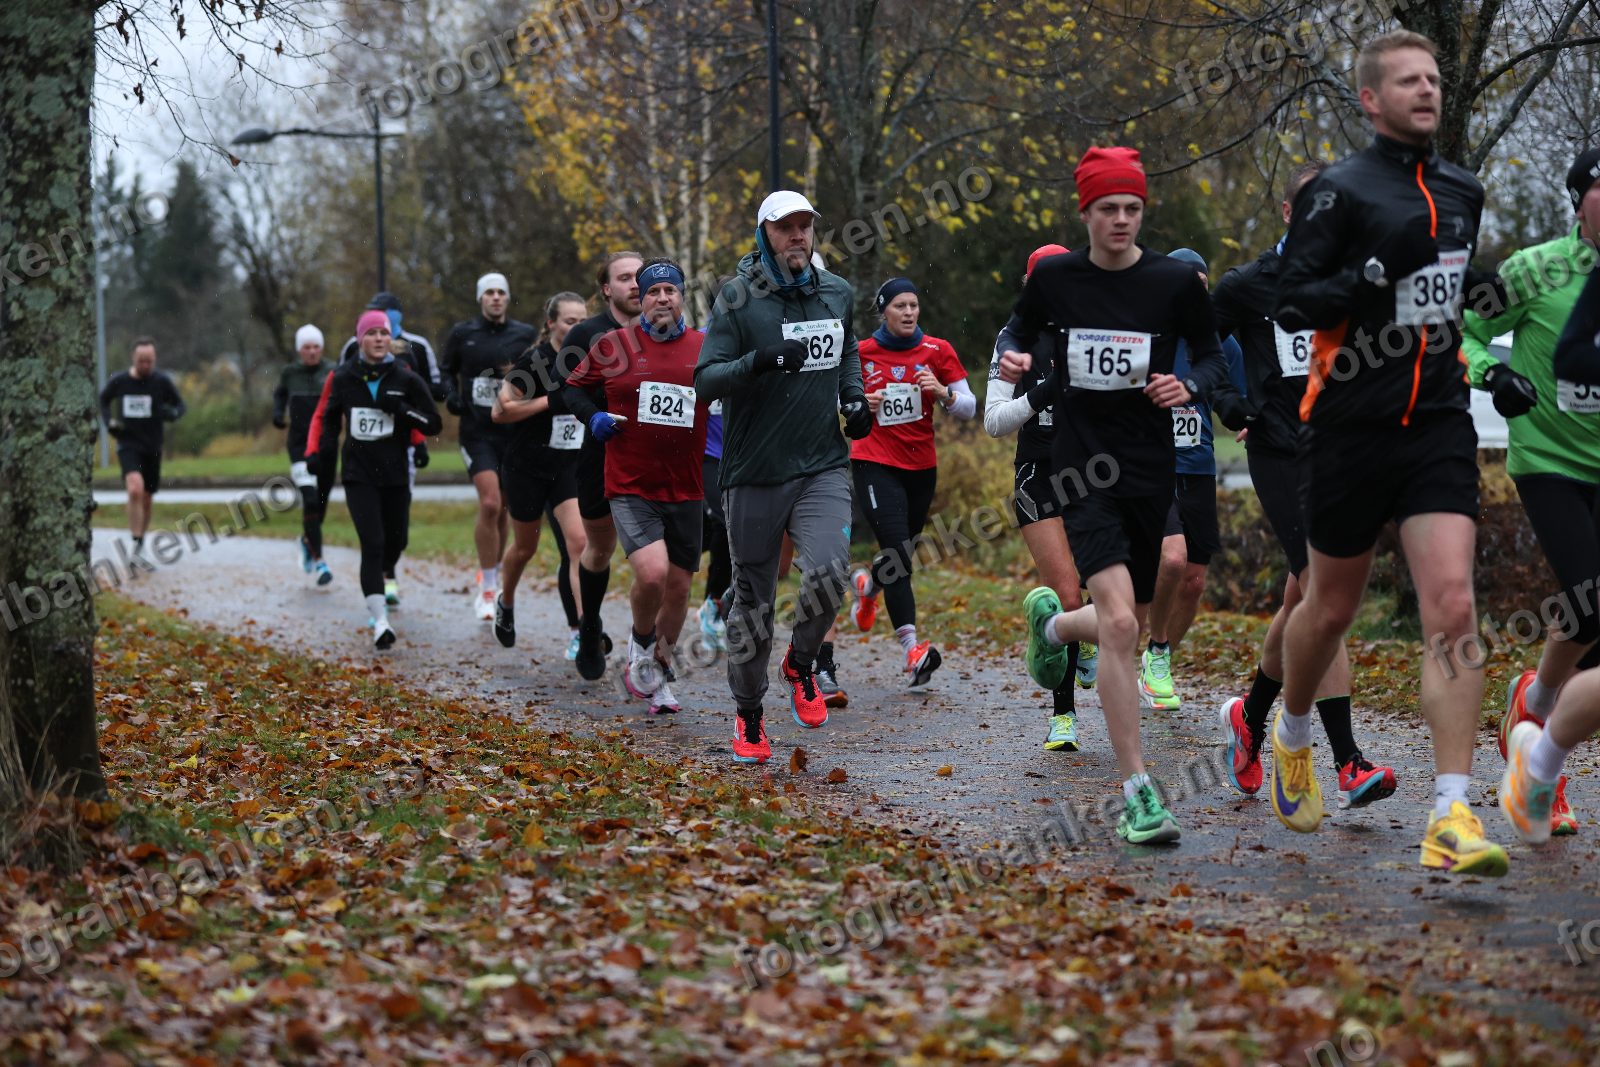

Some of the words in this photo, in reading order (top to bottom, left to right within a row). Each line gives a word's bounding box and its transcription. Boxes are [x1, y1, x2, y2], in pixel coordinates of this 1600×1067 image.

[1414, 272, 1459, 307] 385
[801, 334, 834, 360] 62
[1076, 334, 1145, 344] NORGESTESTEN
[1293, 335, 1314, 362] 6
[1084, 346, 1132, 376] 165
[1574, 383, 1600, 400] 5
[650, 395, 684, 417] 824
[883, 397, 914, 417] 664
[360, 418, 384, 433] 671
[563, 424, 576, 441] 82
[1175, 417, 1198, 436] 20
